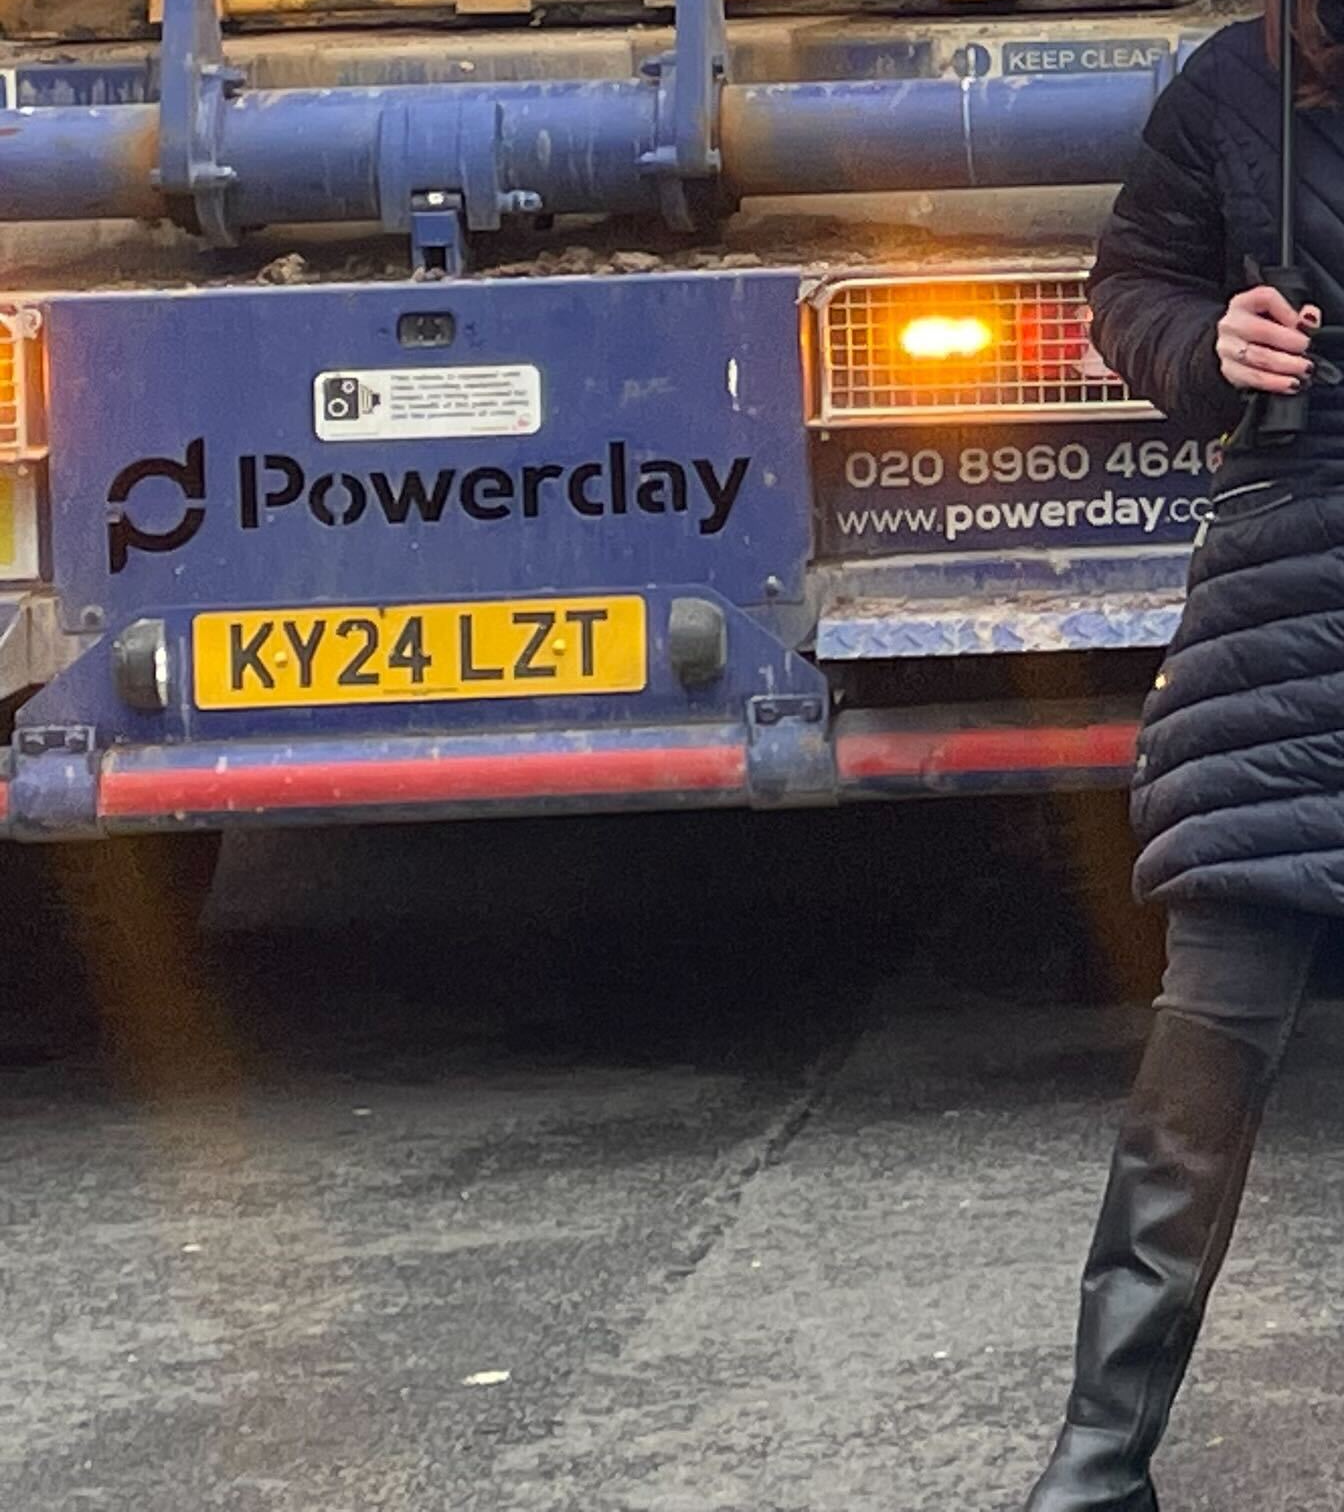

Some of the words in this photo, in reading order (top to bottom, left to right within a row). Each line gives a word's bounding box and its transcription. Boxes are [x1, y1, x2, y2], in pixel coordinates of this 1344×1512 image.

[1008, 50, 1075, 71] KEEP
[239, 441, 751, 535] Powerday
[845, 448, 944, 488] 020
[958, 442, 1090, 485] 8960
[230, 616, 432, 689] KY24
[458, 608, 609, 681] LZT
